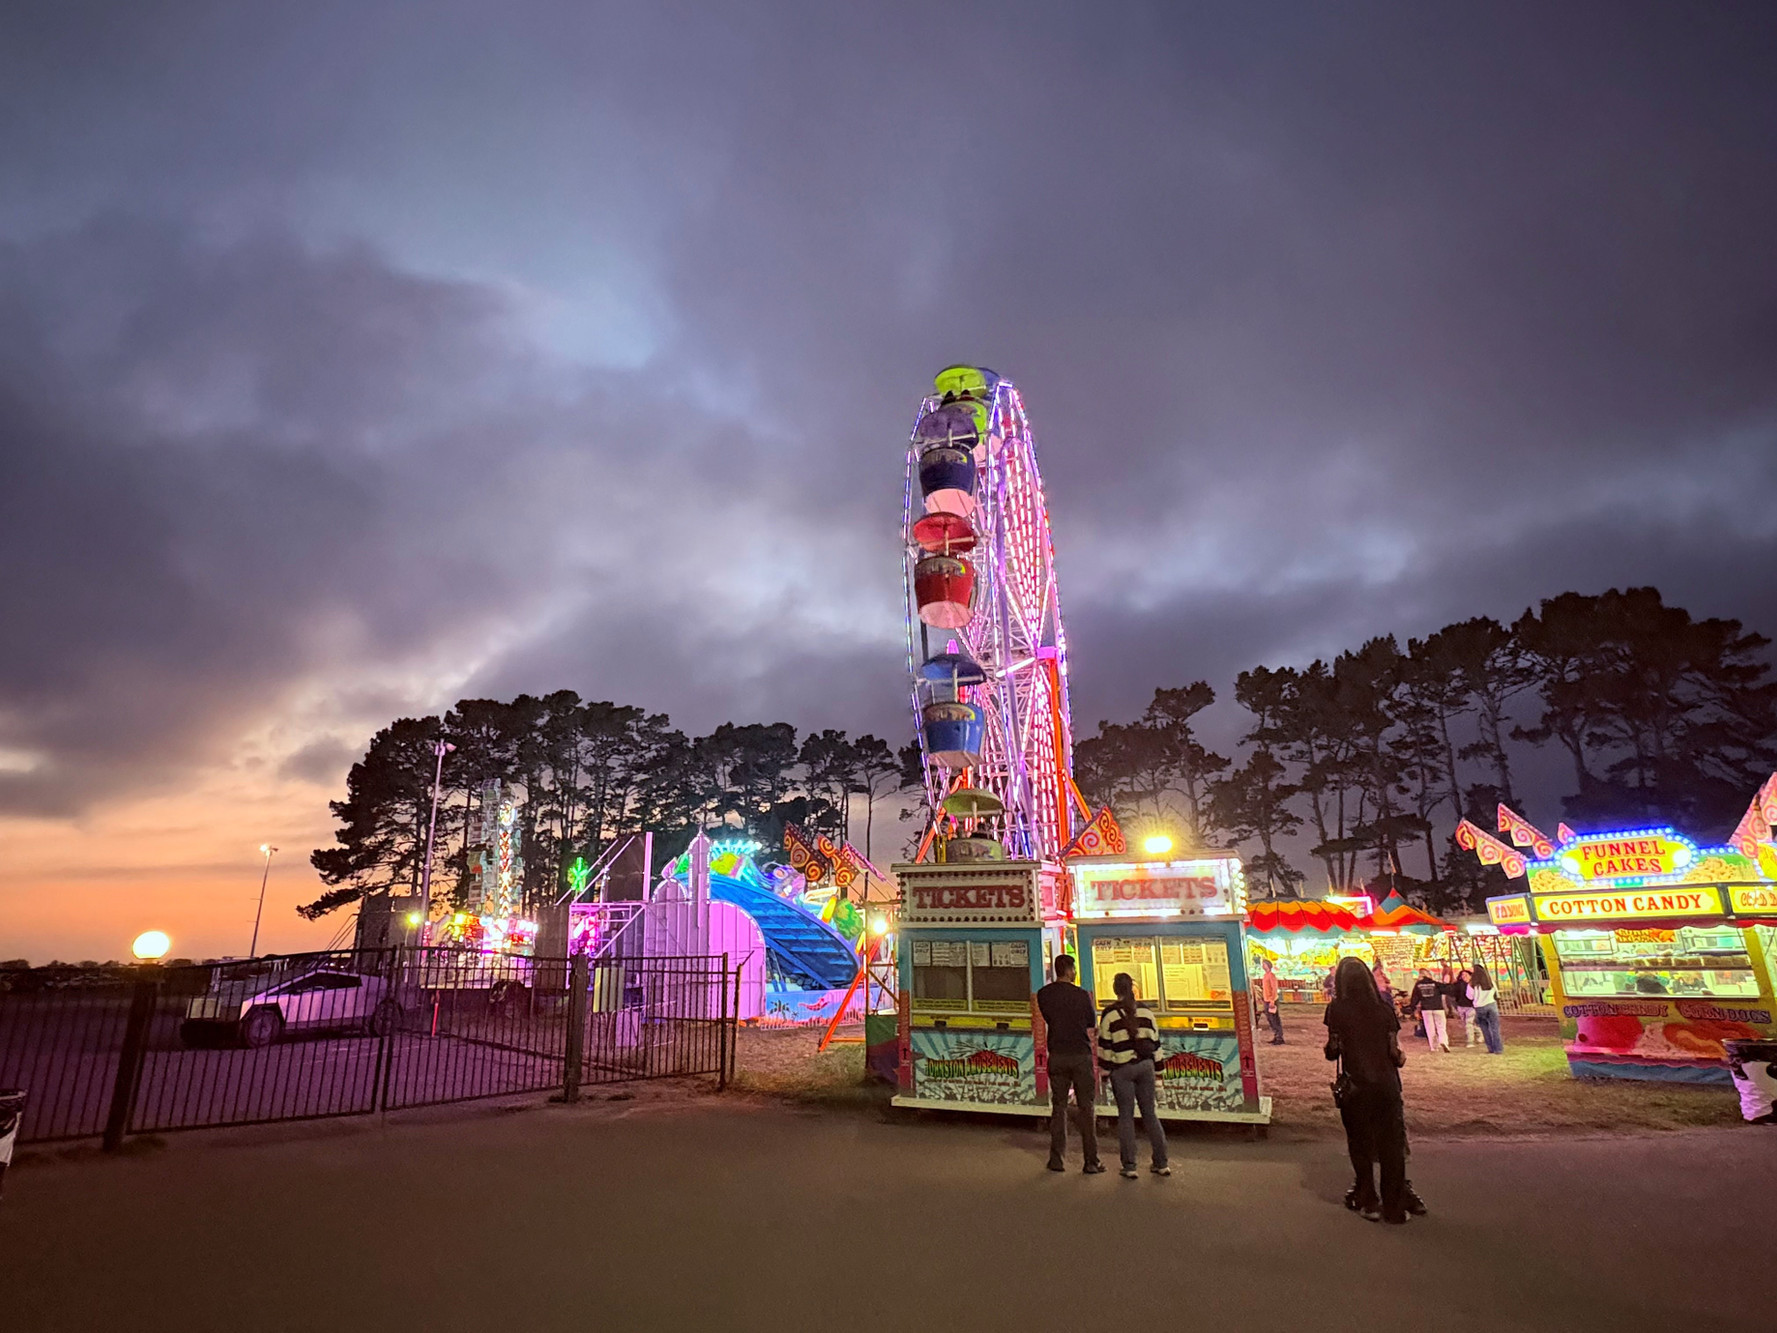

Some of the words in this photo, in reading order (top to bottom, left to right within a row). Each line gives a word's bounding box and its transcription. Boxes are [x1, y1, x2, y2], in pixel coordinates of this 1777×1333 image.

[1581, 840, 1666, 860] FUNNEL
[1593, 858, 1662, 876] CAKES
[911, 884, 1026, 910] TICKETS
[1090, 876, 1218, 901] TICKETS
[1549, 898, 1627, 915] COTTON
[1633, 894, 1702, 911] CANDY
[1564, 1003, 1618, 1018] COTTON
[1619, 1003, 1669, 1017] CANDY
[1679, 1003, 1726, 1021] CORN
[1725, 1007, 1772, 1024] DOGS
